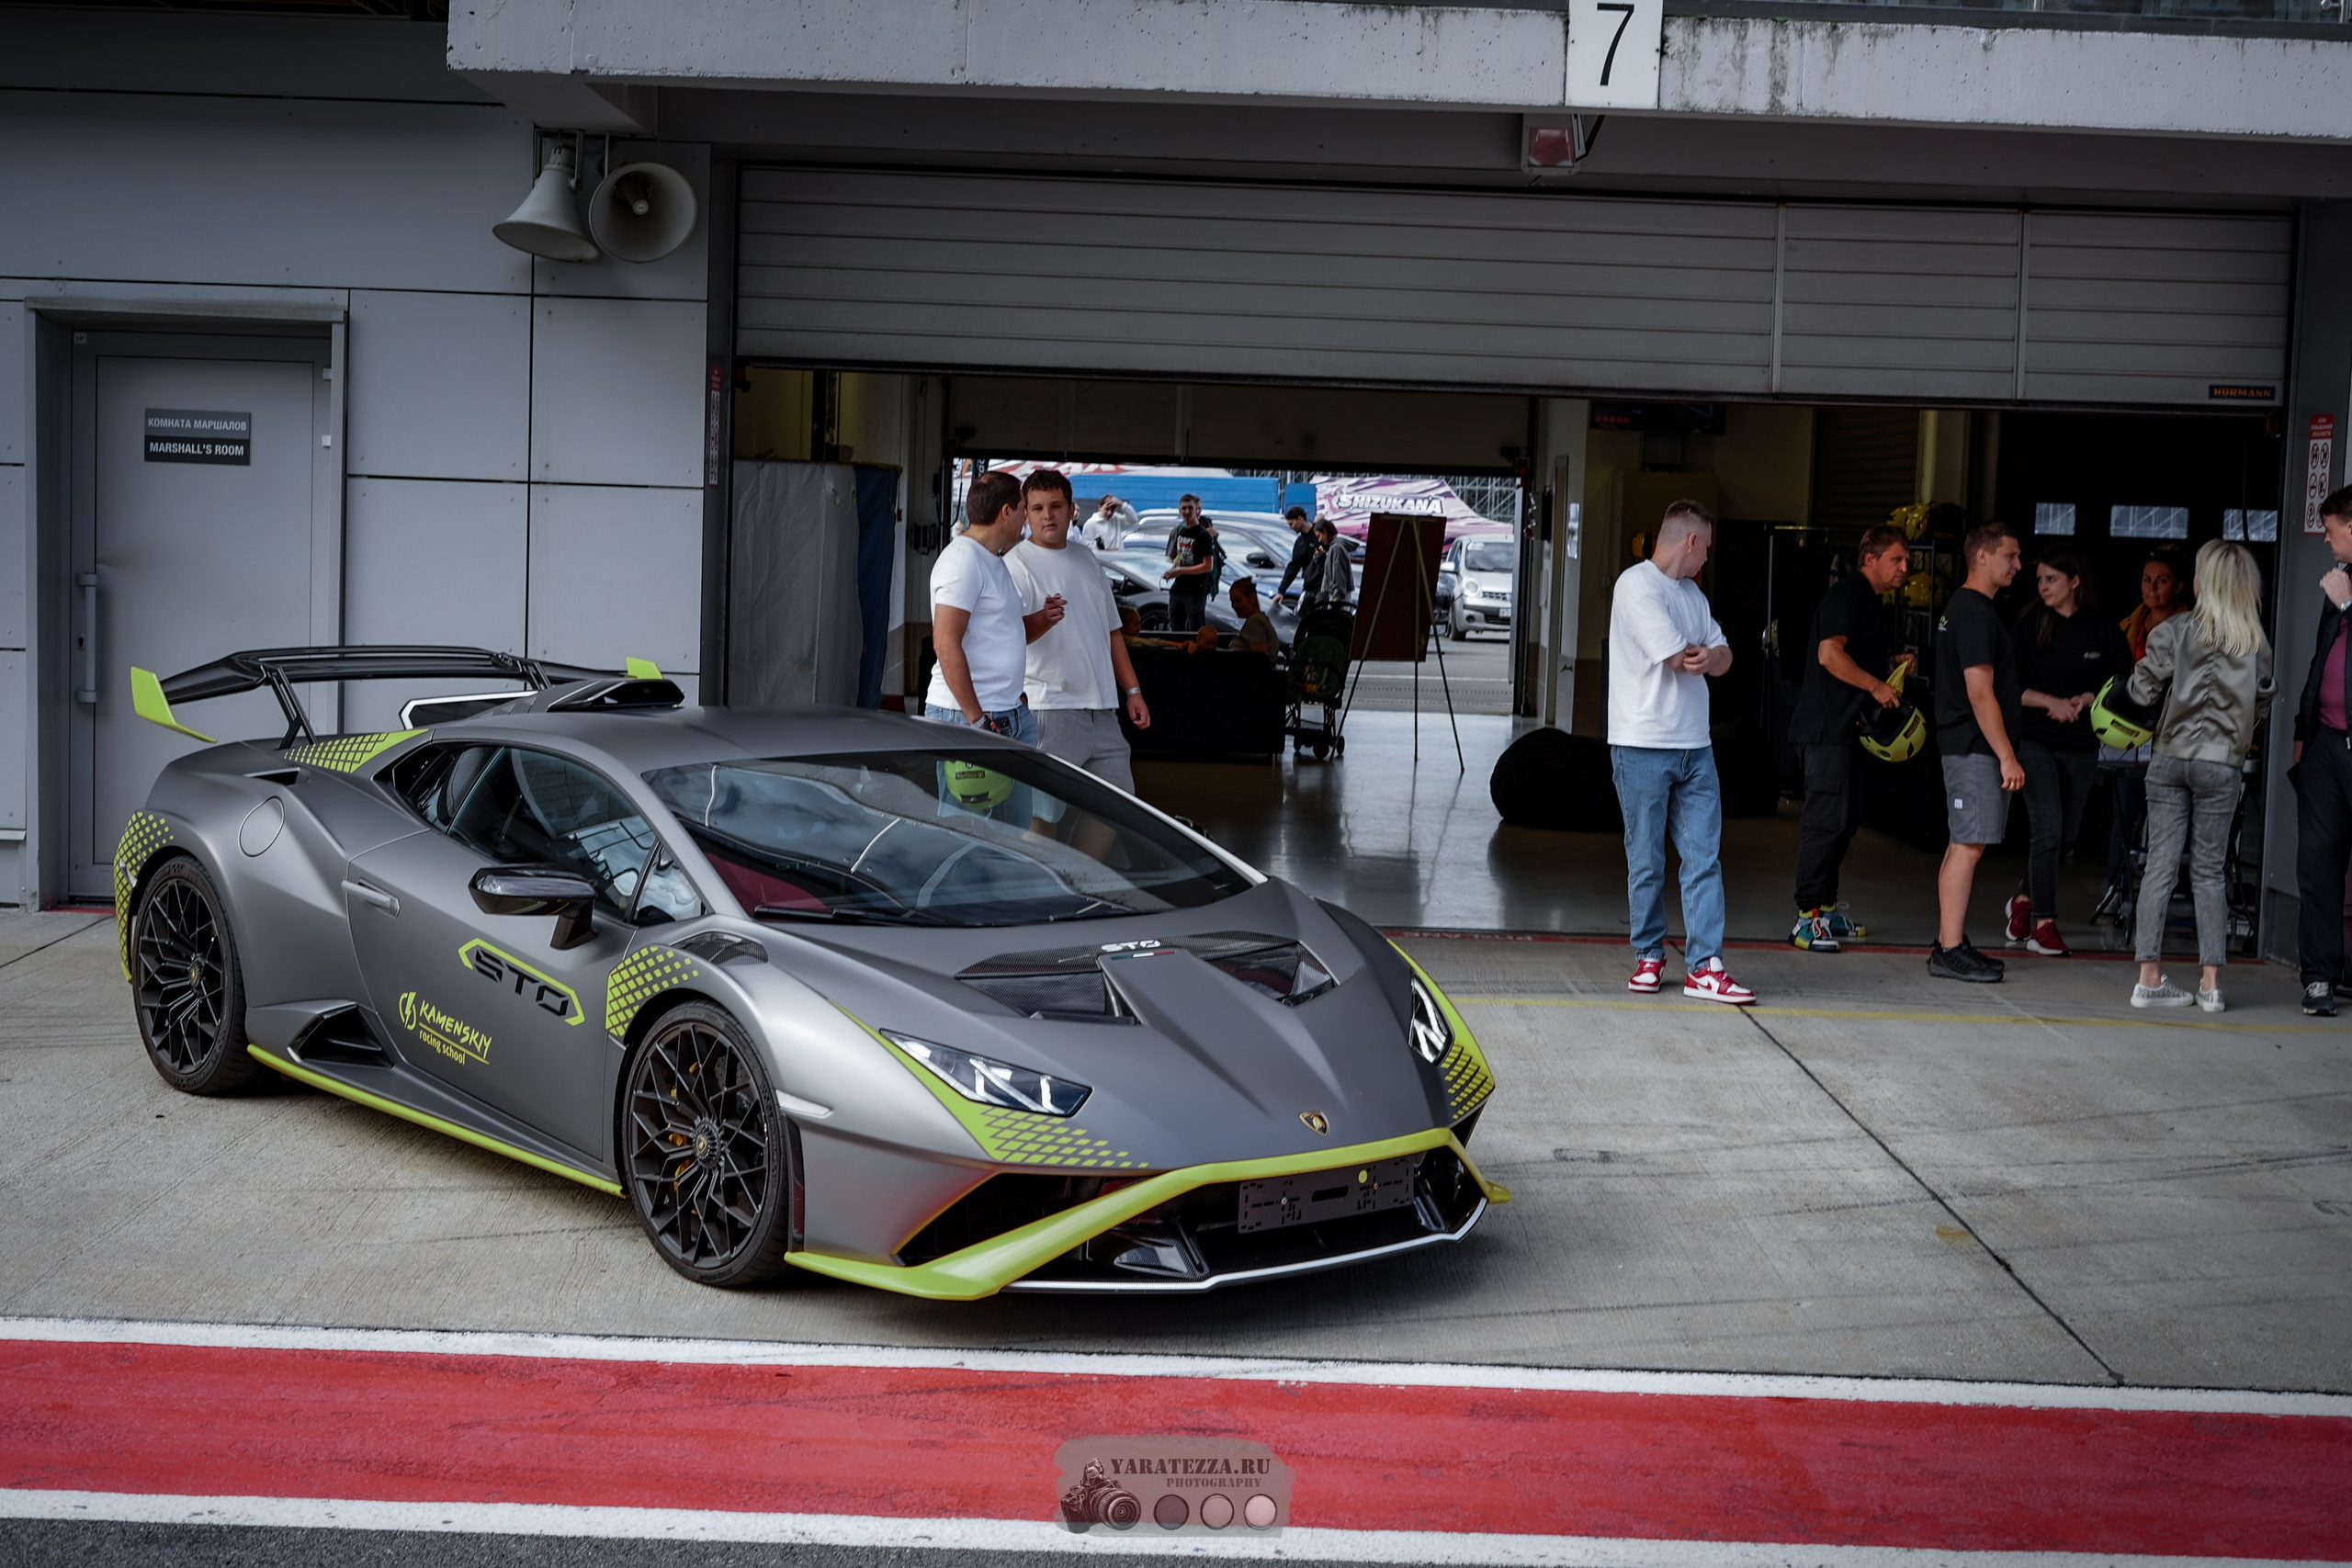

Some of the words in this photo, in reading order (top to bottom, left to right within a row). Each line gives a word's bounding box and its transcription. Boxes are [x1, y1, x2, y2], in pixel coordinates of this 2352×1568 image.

[1597, 3, 1634, 86] 7
[148, 417, 191, 429] КОМНАТА
[193, 419, 246, 432] МАРШАЛОВ
[150, 442, 212, 455] MARSHALL'S
[214, 444, 244, 457] ROOM
[1338, 494, 1442, 513] SHIZUKANA
[1101, 939, 1161, 953] STO
[473, 949, 570, 1017] STO
[419, 999, 492, 1059] KAMENSKIY
[419, 1029, 442, 1055] racing
[442, 1044, 466, 1066] school
